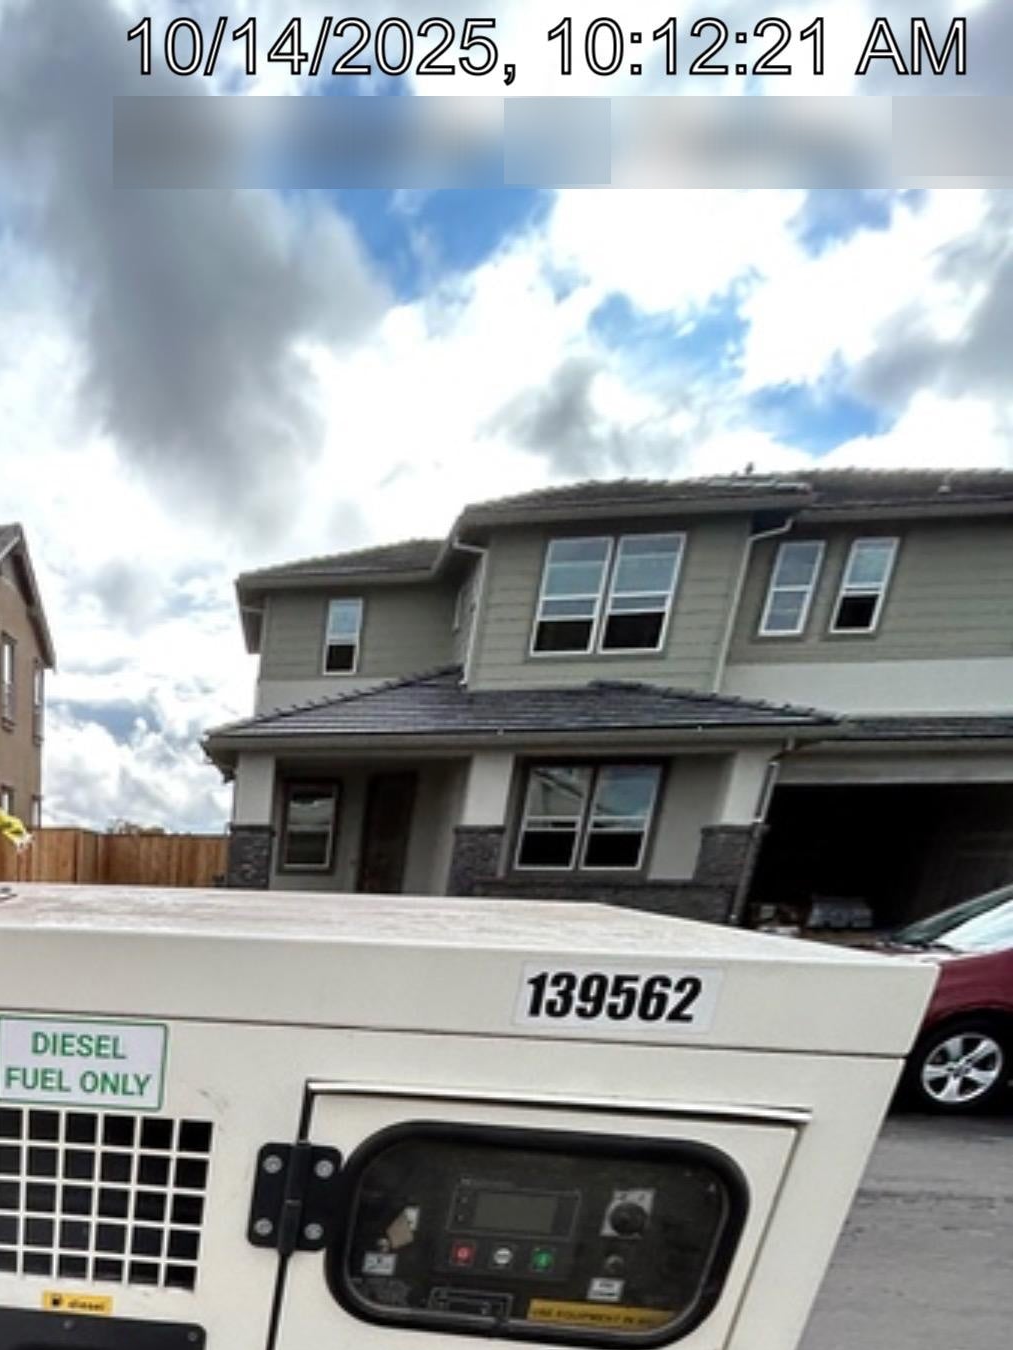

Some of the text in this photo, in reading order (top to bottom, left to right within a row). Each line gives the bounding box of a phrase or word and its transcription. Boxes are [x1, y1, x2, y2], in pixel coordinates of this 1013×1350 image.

[527, 971, 703, 1023] 139562
[31, 1031, 127, 1060] DIESEL
[4, 1066, 152, 1096] FUEL ONLY
